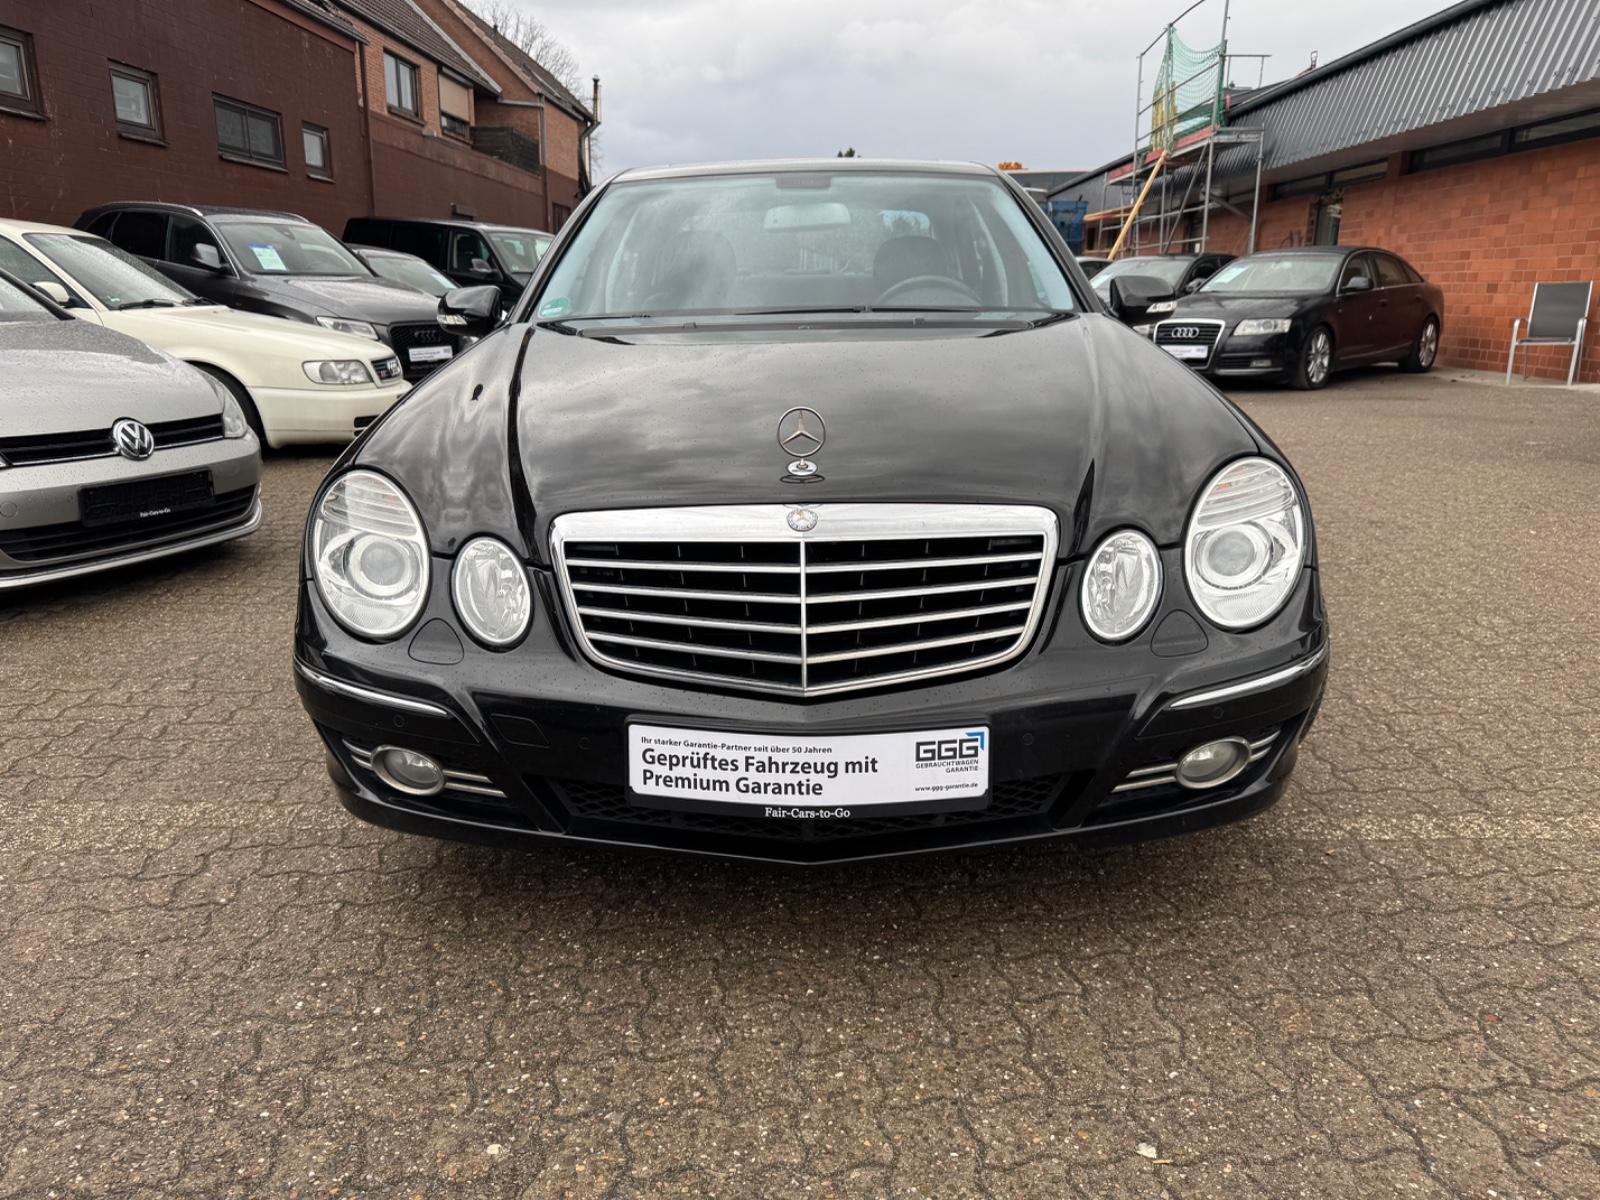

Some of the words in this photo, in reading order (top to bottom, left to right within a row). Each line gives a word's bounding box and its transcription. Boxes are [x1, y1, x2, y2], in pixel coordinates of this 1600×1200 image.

[641, 736, 652, 744] Ihr
[653, 738, 682, 747] starker
[683, 740, 752, 752] Garantie-Partner
[753, 745, 768, 753] seit
[771, 746, 790, 754] über
[792, 746, 802, 754] 50
[804, 746, 832, 754] Jahren
[915, 738, 979, 762] GGG
[641, 748, 739, 772] Geprüftes
[744, 755, 839, 779] Fahrzeug
[845, 756, 878, 773] mit
[915, 760, 979, 769] GEBRAUCHTWAGEN
[642, 769, 730, 793] Premium
[735, 777, 823, 796] Garantie
[764, 807, 851, 819] Fair-Cars-to-Go
